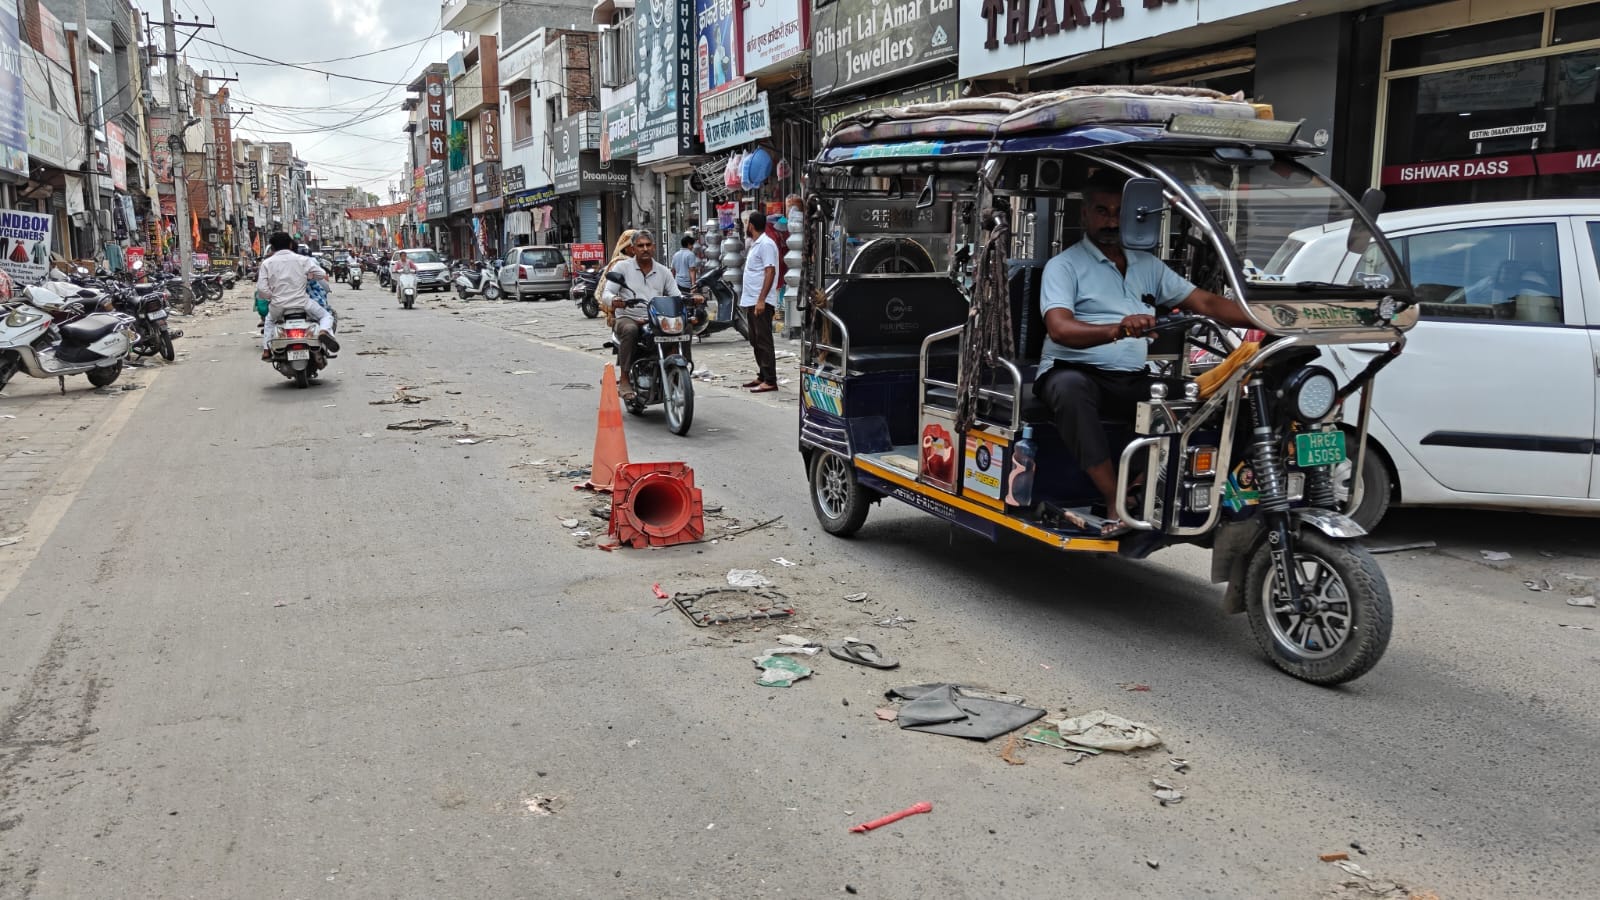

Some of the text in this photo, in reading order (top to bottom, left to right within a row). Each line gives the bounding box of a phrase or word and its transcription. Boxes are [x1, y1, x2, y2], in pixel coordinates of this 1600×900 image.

[815, 17, 852, 57] Bihari
[857, 8, 876, 41] Lal
[881, 0, 922, 31] Amar
[680, 0, 690, 149] HYAM BAKERS
[846, 36, 914, 82] Jewellers
[430, 101, 444, 154] पंसारी
[485, 111, 496, 155] JORA
[583, 170, 628, 181] Dream Decor
[1400, 160, 1509, 181] ISHWAR DASS
[0, 213, 49, 232] NDBOX
[1310, 433, 1337, 448] HR62
[966, 468, 1001, 489] E-TIGER
